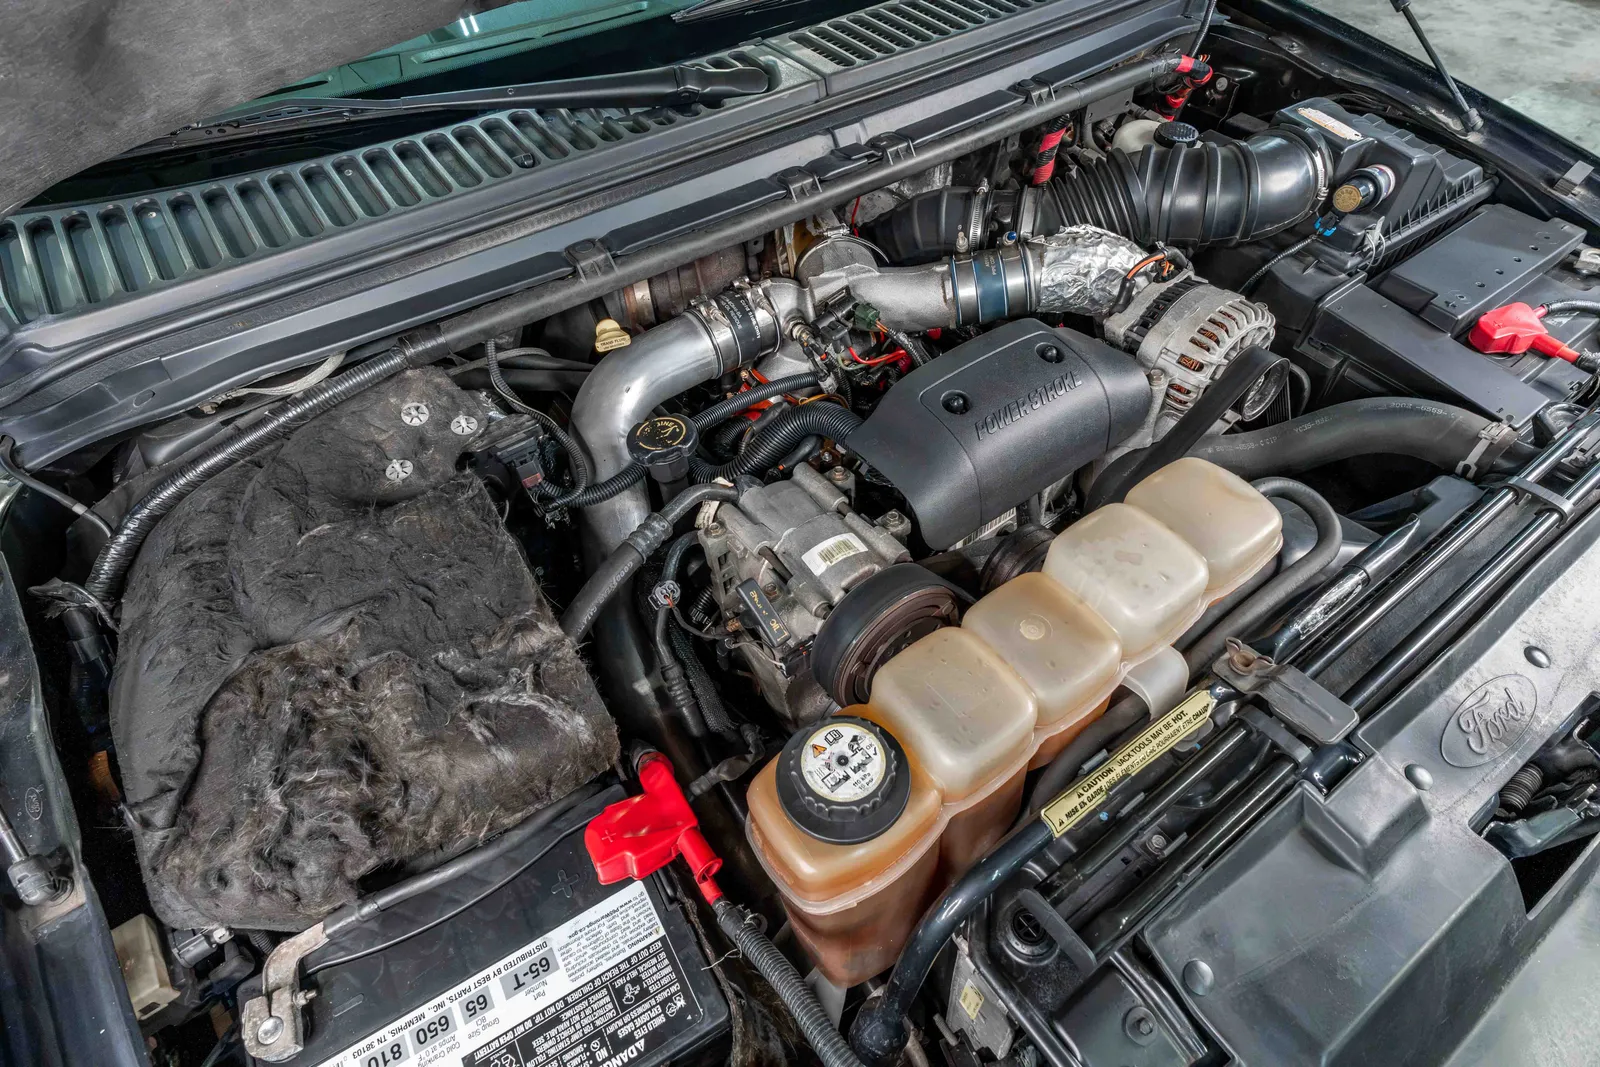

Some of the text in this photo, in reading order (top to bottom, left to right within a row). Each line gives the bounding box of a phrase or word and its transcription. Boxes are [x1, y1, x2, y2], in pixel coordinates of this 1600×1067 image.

[751, 325, 763, 338] Only
[974, 370, 1083, 441] POWER STROKE
[769, 618, 780, 634] OIL
[1458, 687, 1526, 755] Ford
[866, 743, 875, 751] OK
[1082, 710, 1187, 792] CAUTION: JACK TOOLS MAY BE HOT.
[1065, 805, 1079, 819] MISE
[1078, 799, 1087, 809] EN
[1105, 776, 1116, 787] DES
[1155, 725, 1181, 748] POURRAIENT
[503, 941, 547, 970] DISTRIBUTED
[656, 958, 669, 969] WITH
[492, 967, 502, 978] BY
[513, 957, 550, 990] 65-T
[612, 951, 666, 987] GET MEDICAL HELP FAST.
[642, 964, 672, 987] IMMEDIATELY
[473, 974, 491, 989] BEST
[524, 979, 547, 996] Number
[648, 971, 675, 992] FLUSH EYES
[446, 985, 471, 1003] PARTS,
[474, 940, 662, 1060] KEEP OUT OF THE REACH OF CHILDREN. DO NOT TIP. DO NOT OPEN BATTERY!
[532, 989, 545, 1000] Part
[590, 995, 610, 1010] MANUAL
[465, 994, 487, 1017] 65
[559, 988, 607, 1020] SERVICE ASSISTANCE.
[606, 982, 680, 1034] CAN CAUSE BLINDNESS OR INJURY
[475, 1015, 486, 1026] BCI
[569, 1014, 580, 1024] NOT
[579, 1010, 585, 1018] IF
[580, 1002, 613, 1025] INSTRUCTIONS
[593, 1009, 616, 1026] CAUTION:
[617, 1005, 661, 1037] EXPLOSIVE GASES
[388, 1012, 425, 1036] MEMPHIS,
[416, 1015, 449, 1044] 650
[467, 1017, 499, 1039] Group Size
[582, 1023, 593, 1033] FOR
[633, 1013, 665, 1039] SHIELD EYES
[376, 1034, 387, 1045] TN
[438, 1034, 455, 1048] Amps
[531, 1035, 544, 1047] SEEK
[555, 1026, 575, 1041] VEHICLE
[570, 1029, 582, 1041] JUMP
[352, 1041, 375, 1059] 38103
[367, 1043, 401, 1067] 810
[430, 1044, 437, 1053] at
[446, 1041, 460, 1053] Cold
[562, 1044, 583, 1062] SMOKING
[595, 1047, 608, 1061] NO
[600, 1045, 637, 1067] DANG
[526, 1052, 546, 1067] FOLLOW
